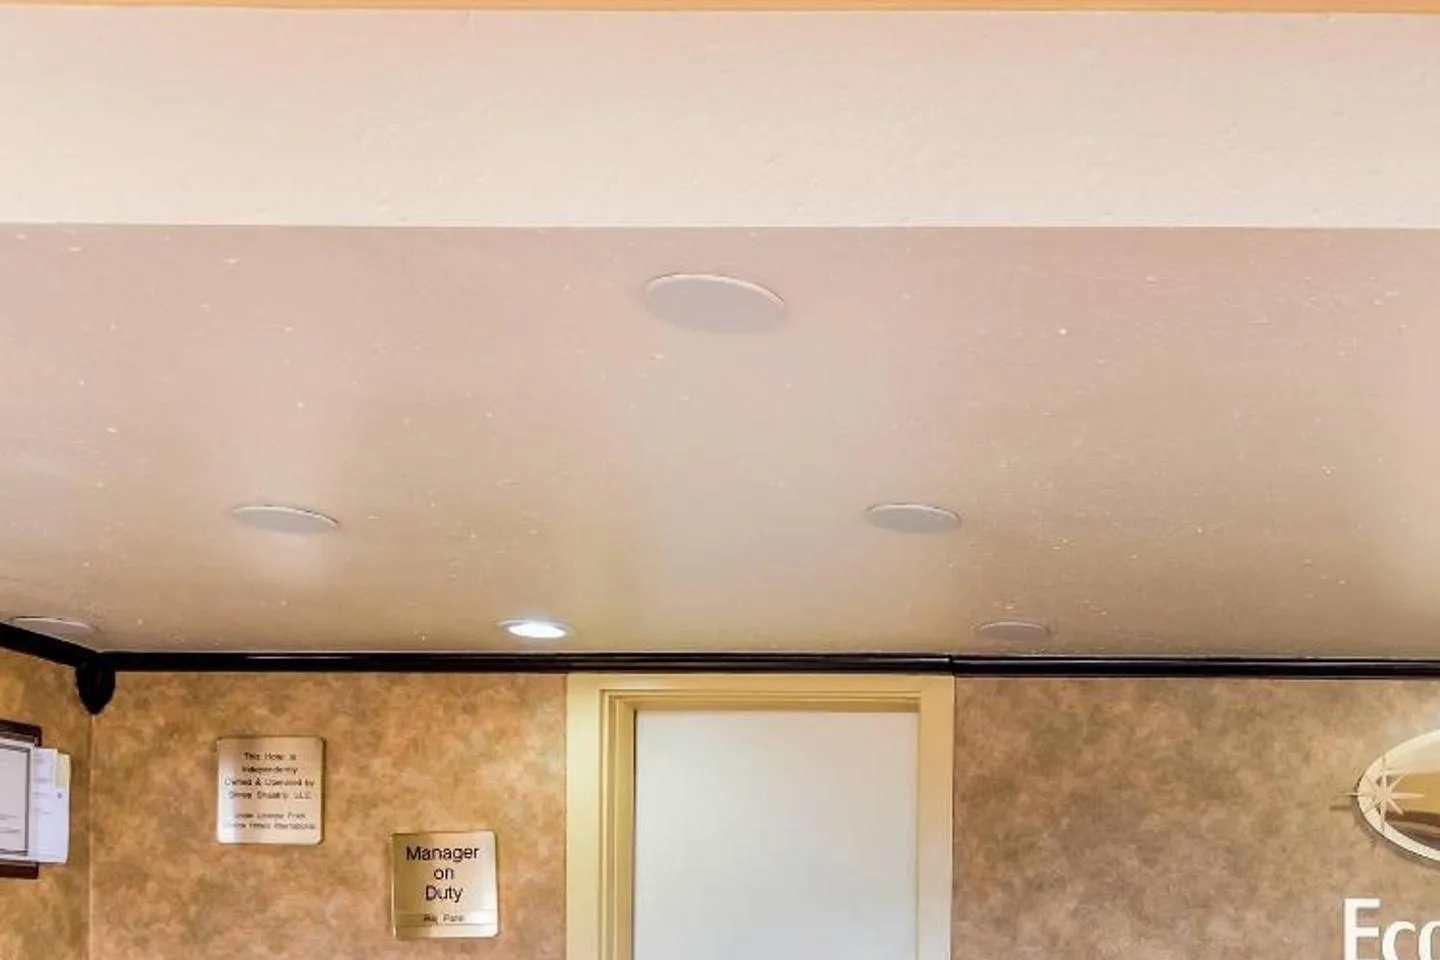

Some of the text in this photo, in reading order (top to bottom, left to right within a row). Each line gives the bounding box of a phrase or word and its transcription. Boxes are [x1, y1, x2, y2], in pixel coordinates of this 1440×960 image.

[406, 846, 480, 862] Manager
[433, 868, 454, 880] on
[425, 885, 463, 903] Duty
